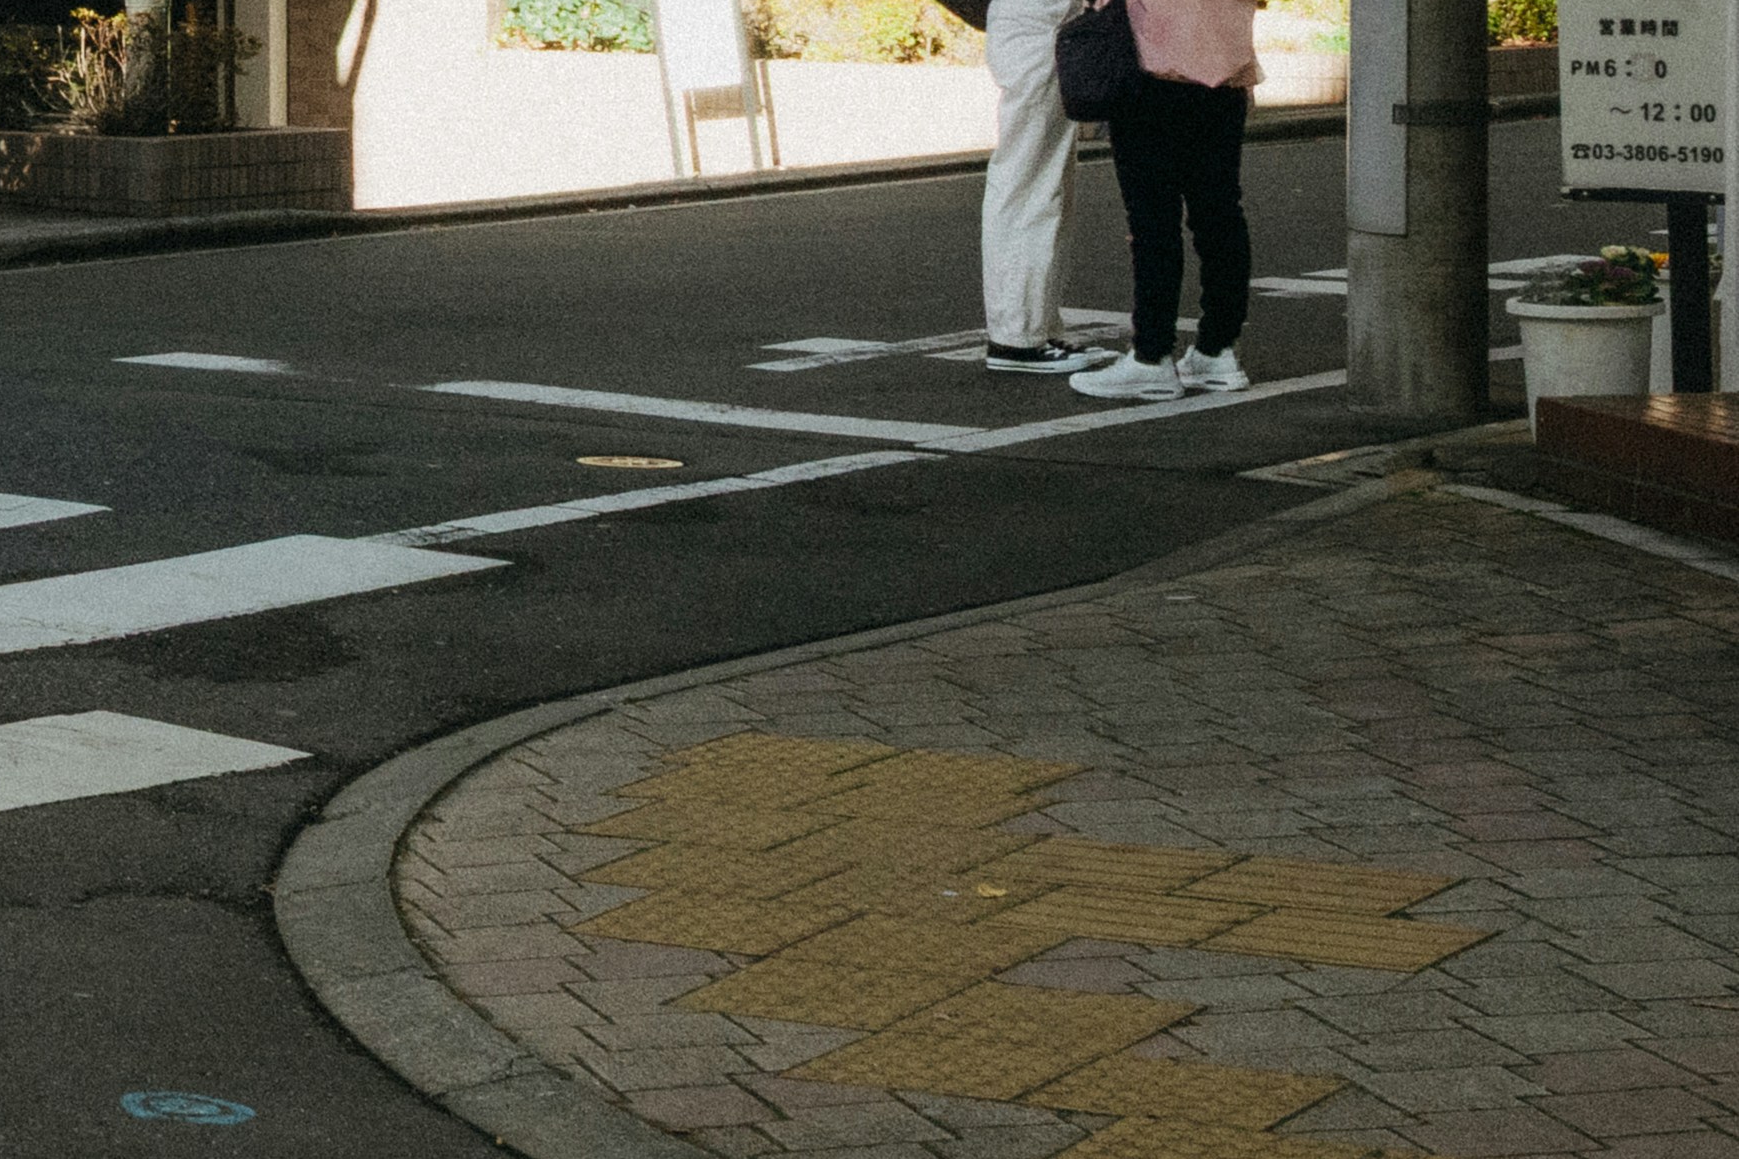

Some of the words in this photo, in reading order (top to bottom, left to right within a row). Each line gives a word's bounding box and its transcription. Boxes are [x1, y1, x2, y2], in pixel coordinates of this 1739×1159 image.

[1599, 18, 1679, 37] 営業時間
[1571, 59, 1667, 79] PM6:0
[1592, 143, 1724, 163] 03-3806-5190
